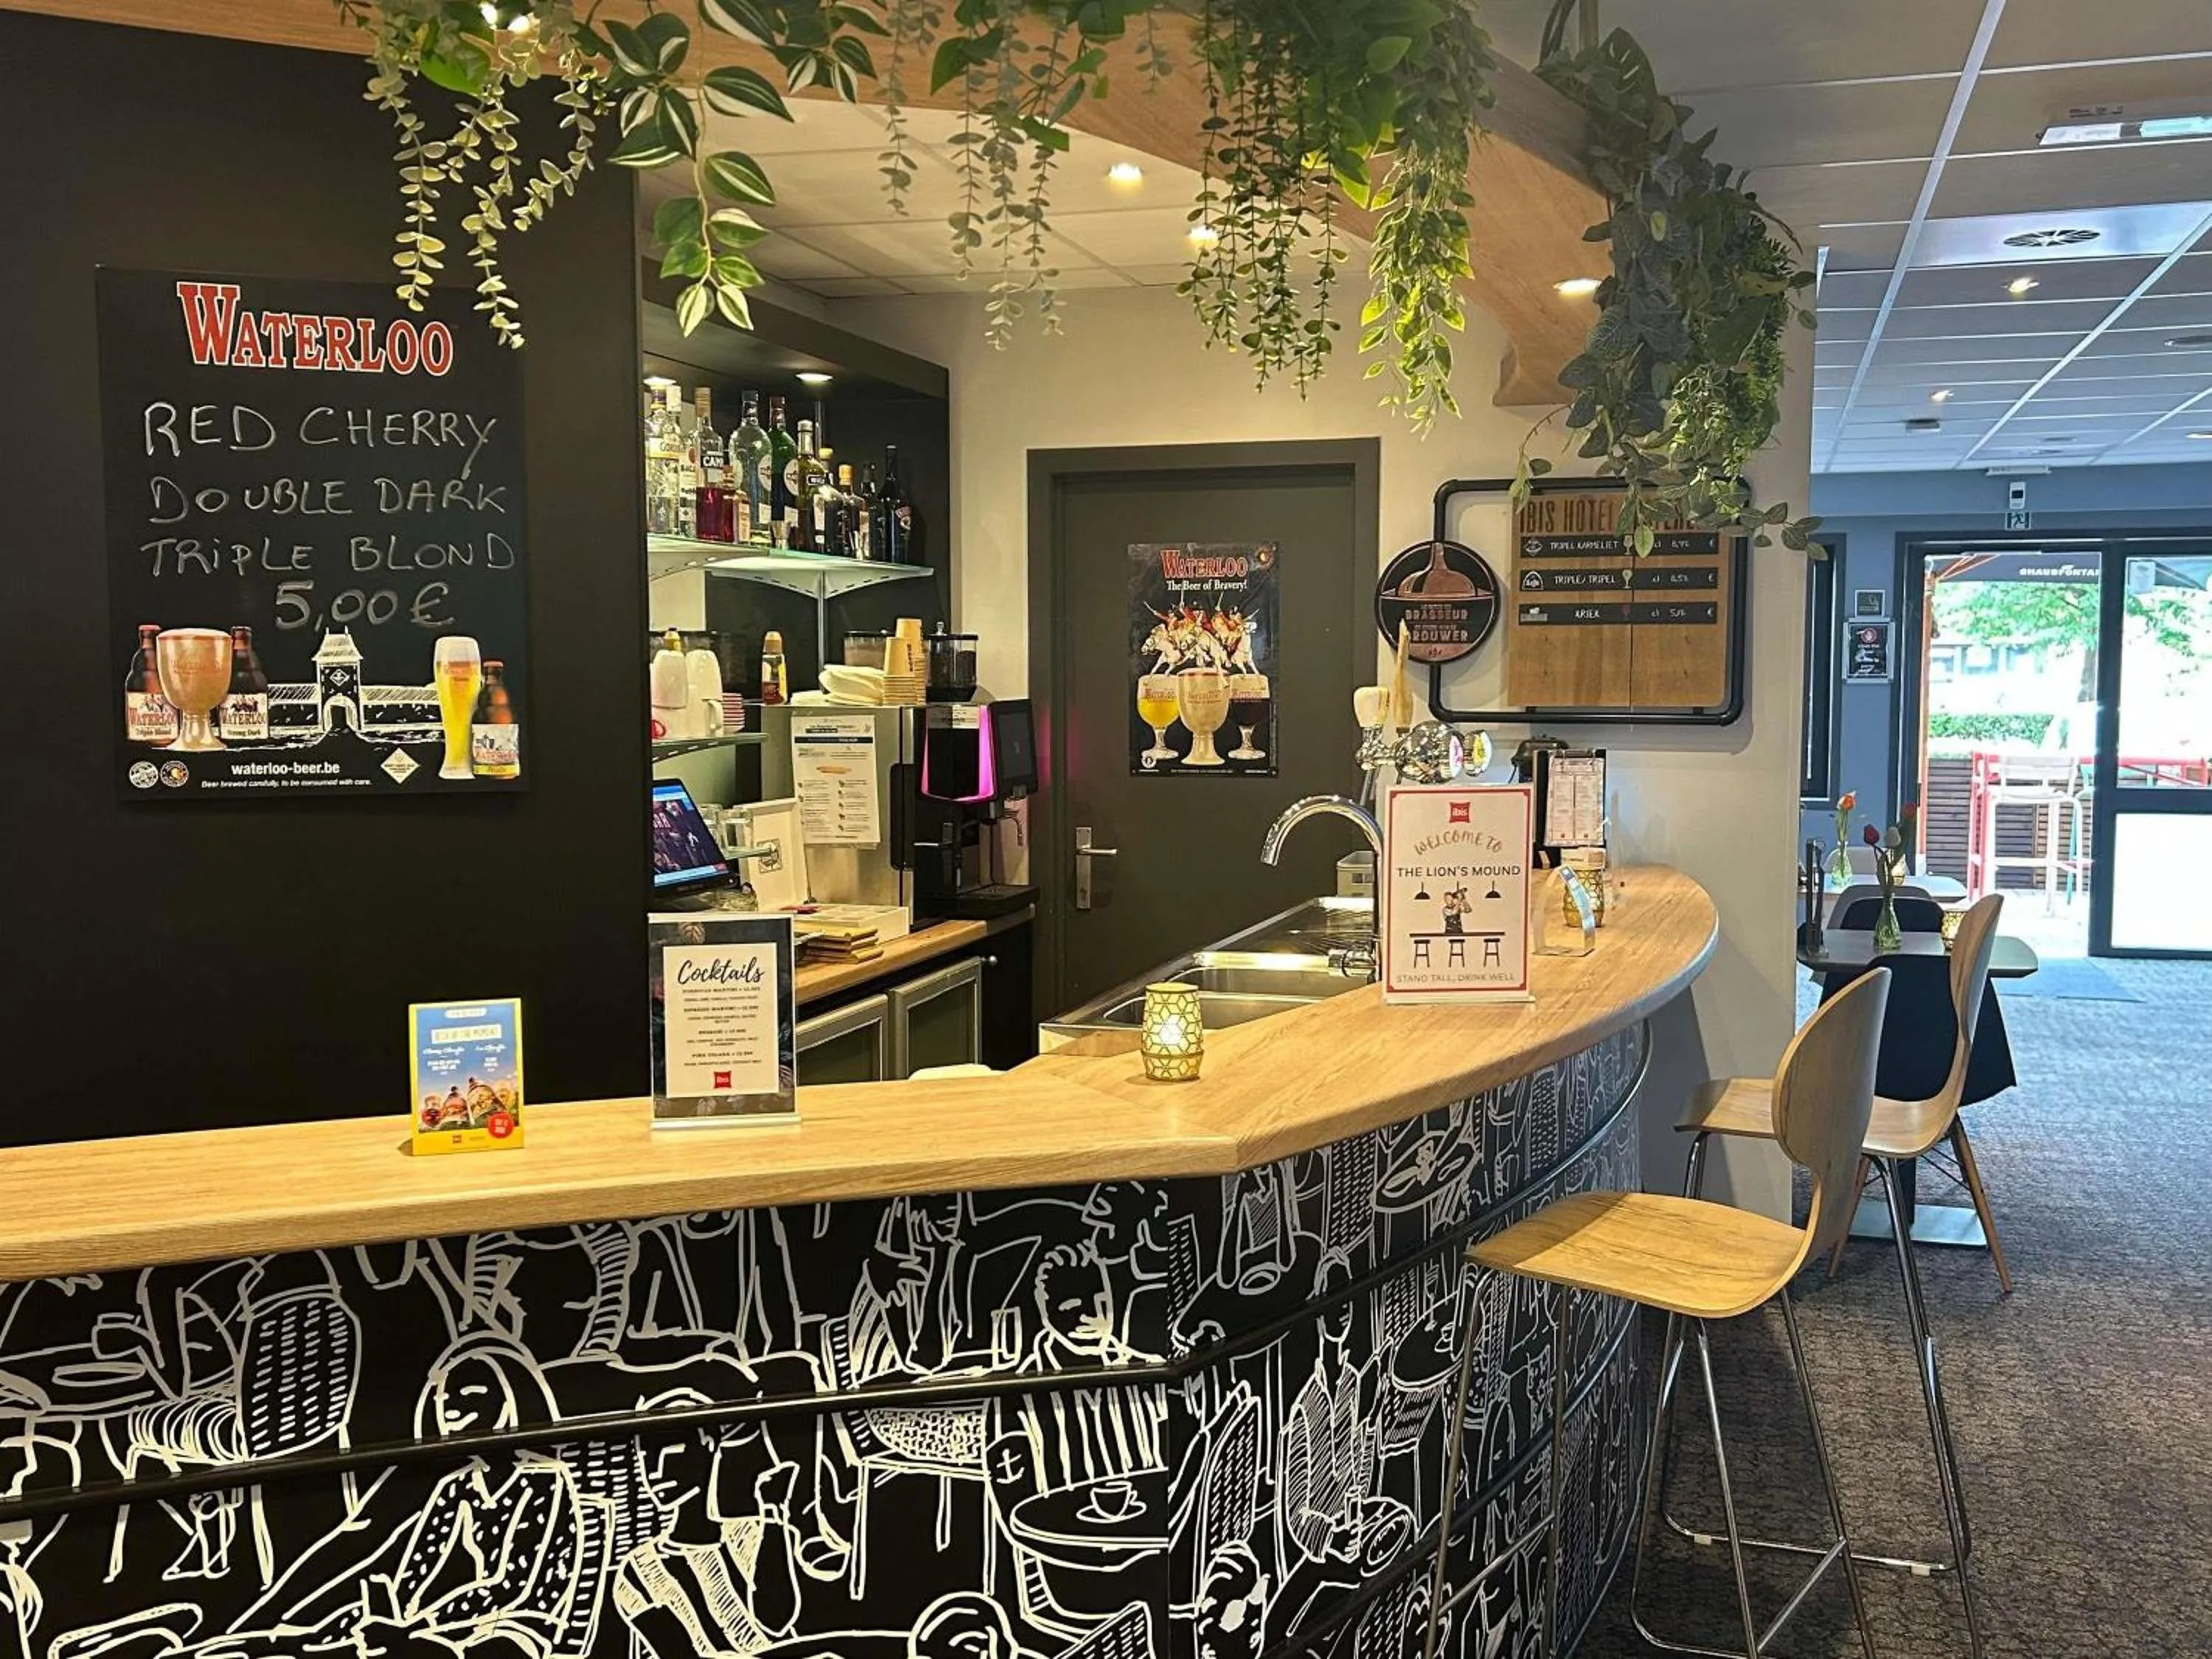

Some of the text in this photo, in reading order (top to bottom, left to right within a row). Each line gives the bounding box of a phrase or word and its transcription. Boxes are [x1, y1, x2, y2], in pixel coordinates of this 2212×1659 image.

[177, 282, 453, 376] WATERLOO
[145, 402, 496, 480] RED CHERRY
[149, 476, 506, 524] DOUBLE DARK
[1520, 501, 1554, 532] IBIS
[350, 532, 515, 571] BLOND
[1160, 549, 1248, 578] WATERLOO
[1166, 579, 1248, 592] The Beer of Bravery!
[1405, 610, 1468, 620] BRASSEUR
[1411, 630, 1468, 641] ROUWER
[231, 762, 340, 775] waterloo-beer.be
[201, 780, 219, 788] Beer
[220, 779, 248, 787] brewed
[1452, 807, 1467, 816] ibis
[1486, 835, 1503, 854] TO
[1397, 865, 1521, 877] THE LION'S MOUND
[678, 956, 765, 985] Cocktails
[1397, 974, 1427, 983] STAND
[1458, 973, 1486, 981] DRINK
[1489, 973, 1516, 981] WELL
